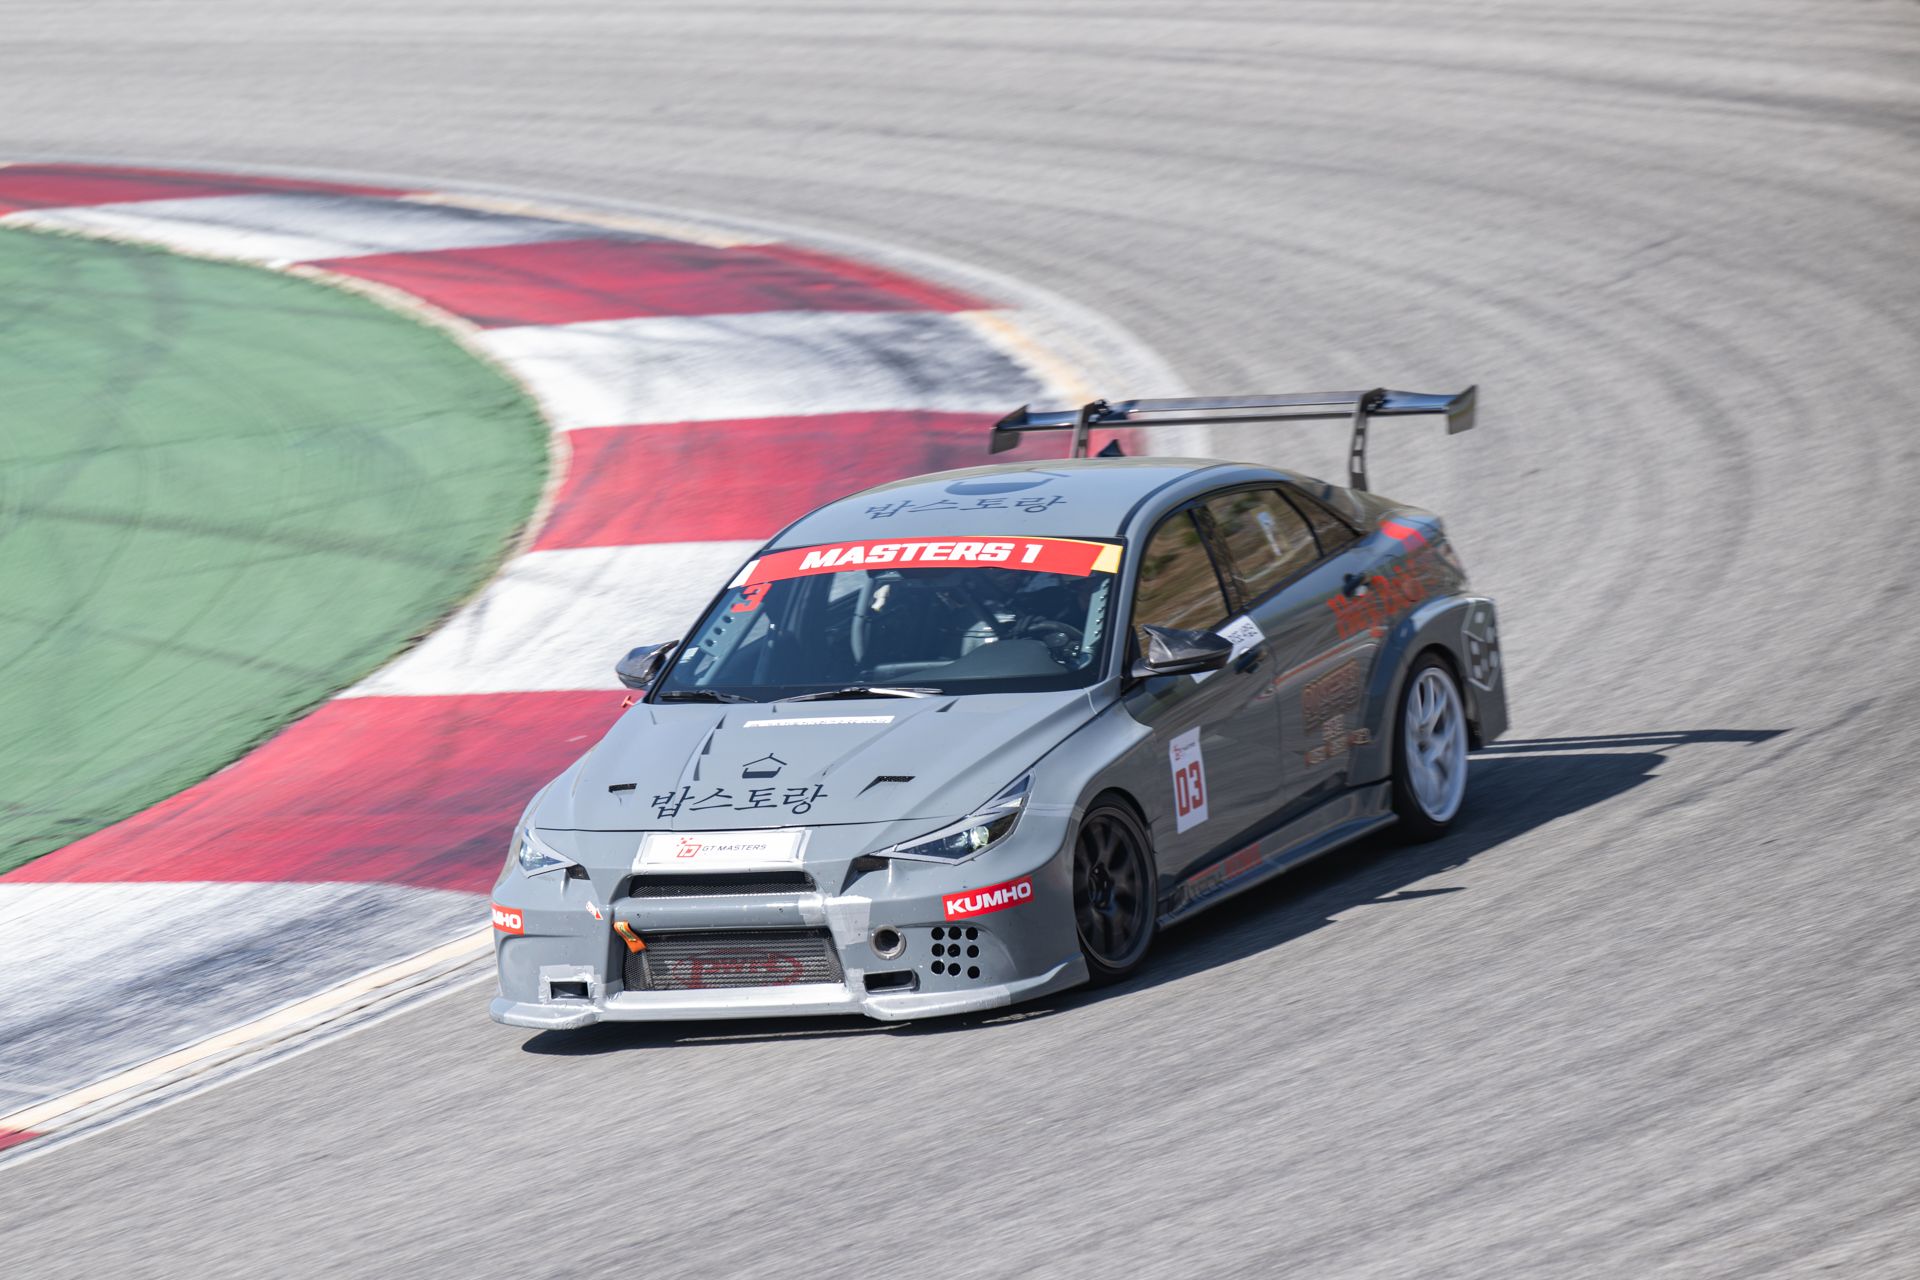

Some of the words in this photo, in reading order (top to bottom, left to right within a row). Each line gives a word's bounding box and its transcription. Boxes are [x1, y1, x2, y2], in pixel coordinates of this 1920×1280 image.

[865, 495, 1067, 519] 밥스토랑
[799, 542, 1015, 570] MASTERS
[1020, 544, 1043, 563] 1
[730, 583, 772, 613] 3
[650, 784, 828, 819] 밥스토랑
[1175, 761, 1204, 817] 03
[946, 882, 1032, 915] KUMHO
[492, 908, 522, 929] MHO
